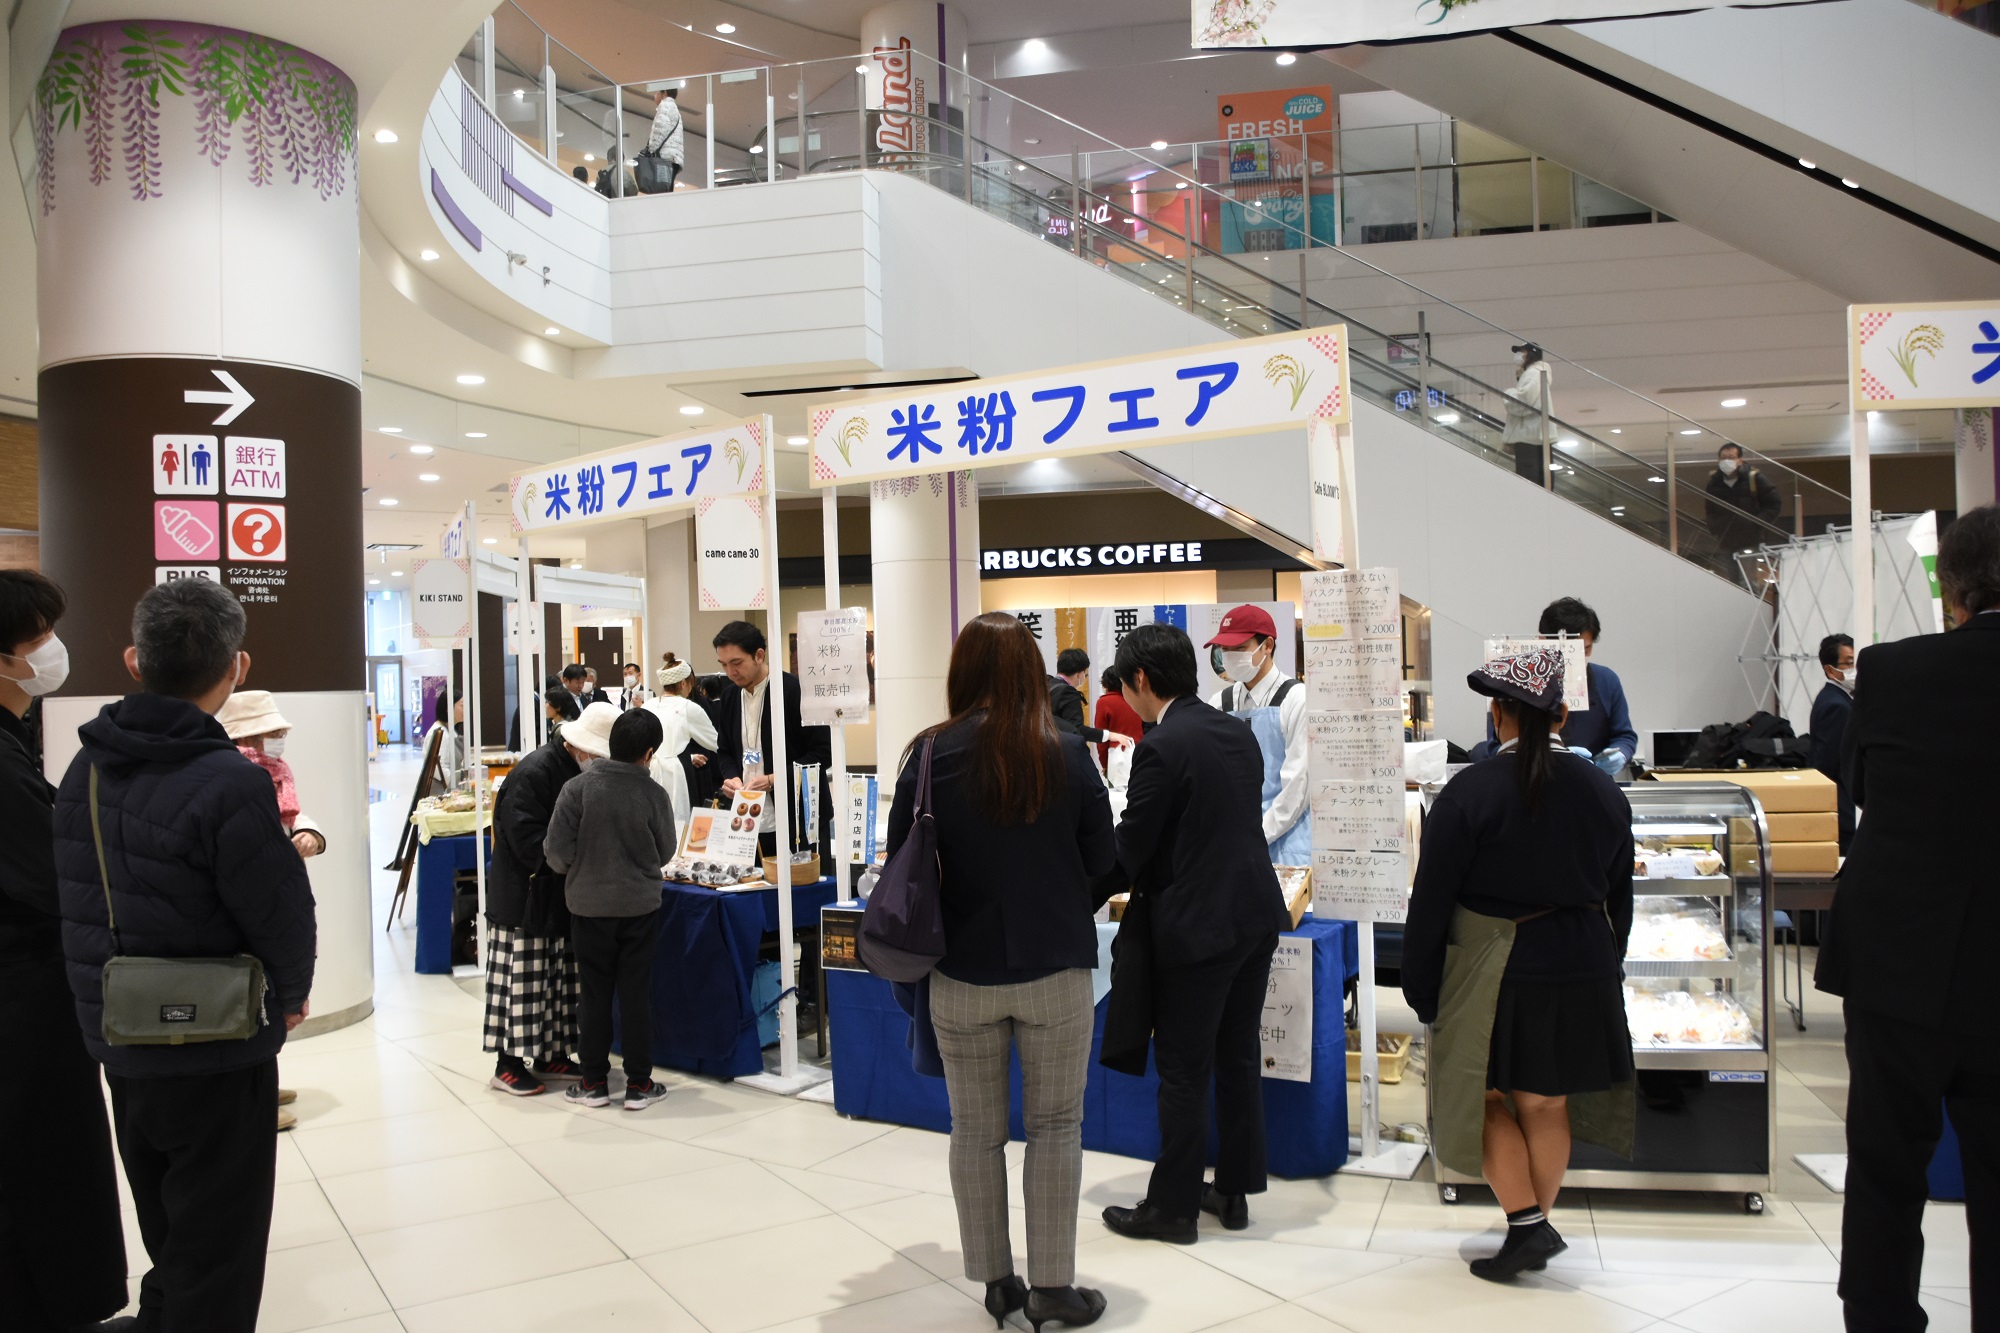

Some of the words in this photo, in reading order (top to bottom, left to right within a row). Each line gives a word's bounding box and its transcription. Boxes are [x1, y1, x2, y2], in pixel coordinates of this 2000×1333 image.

[1298, 97, 1318, 106] COLD
[1285, 103, 1323, 116] JUICE
[1227, 119, 1304, 140] FRESH
[886, 361, 1240, 463] 米粉フェア
[236, 445, 277, 467] 銀行
[231, 469, 280, 489] ATM
[545, 443, 713, 521] 米粉フェア
[749, 548, 759, 559] 30
[977, 547, 1092, 570] RBUCKS
[1098, 542, 1202, 566] COFFEE
[227, 567, 288, 576] インフォメーション
[230, 577, 285, 586] INFORMATION
[419, 594, 436, 602] KIKI
[438, 594, 463, 602] STAND
[817, 643, 841, 658] 米粉
[1312, 643, 1393, 655] クリームと相性抜群
[1307, 657, 1398, 668] ショコラカップケーキ
[807, 664, 853, 676] スイーツ
[814, 683, 850, 697] 販売中
[1309, 715, 1351, 724] BLOOMY'S
[1316, 725, 1393, 734] 米粉のシフォンケーキ
[1321, 785, 1393, 795] アーモンド感じる
[1331, 797, 1384, 807] チーズケーキ
[852, 797, 863, 849] 協力店舗
[1318, 855, 1400, 866] ほろほろなプレーン
[1332, 868, 1386, 879] 米粉クッキー
